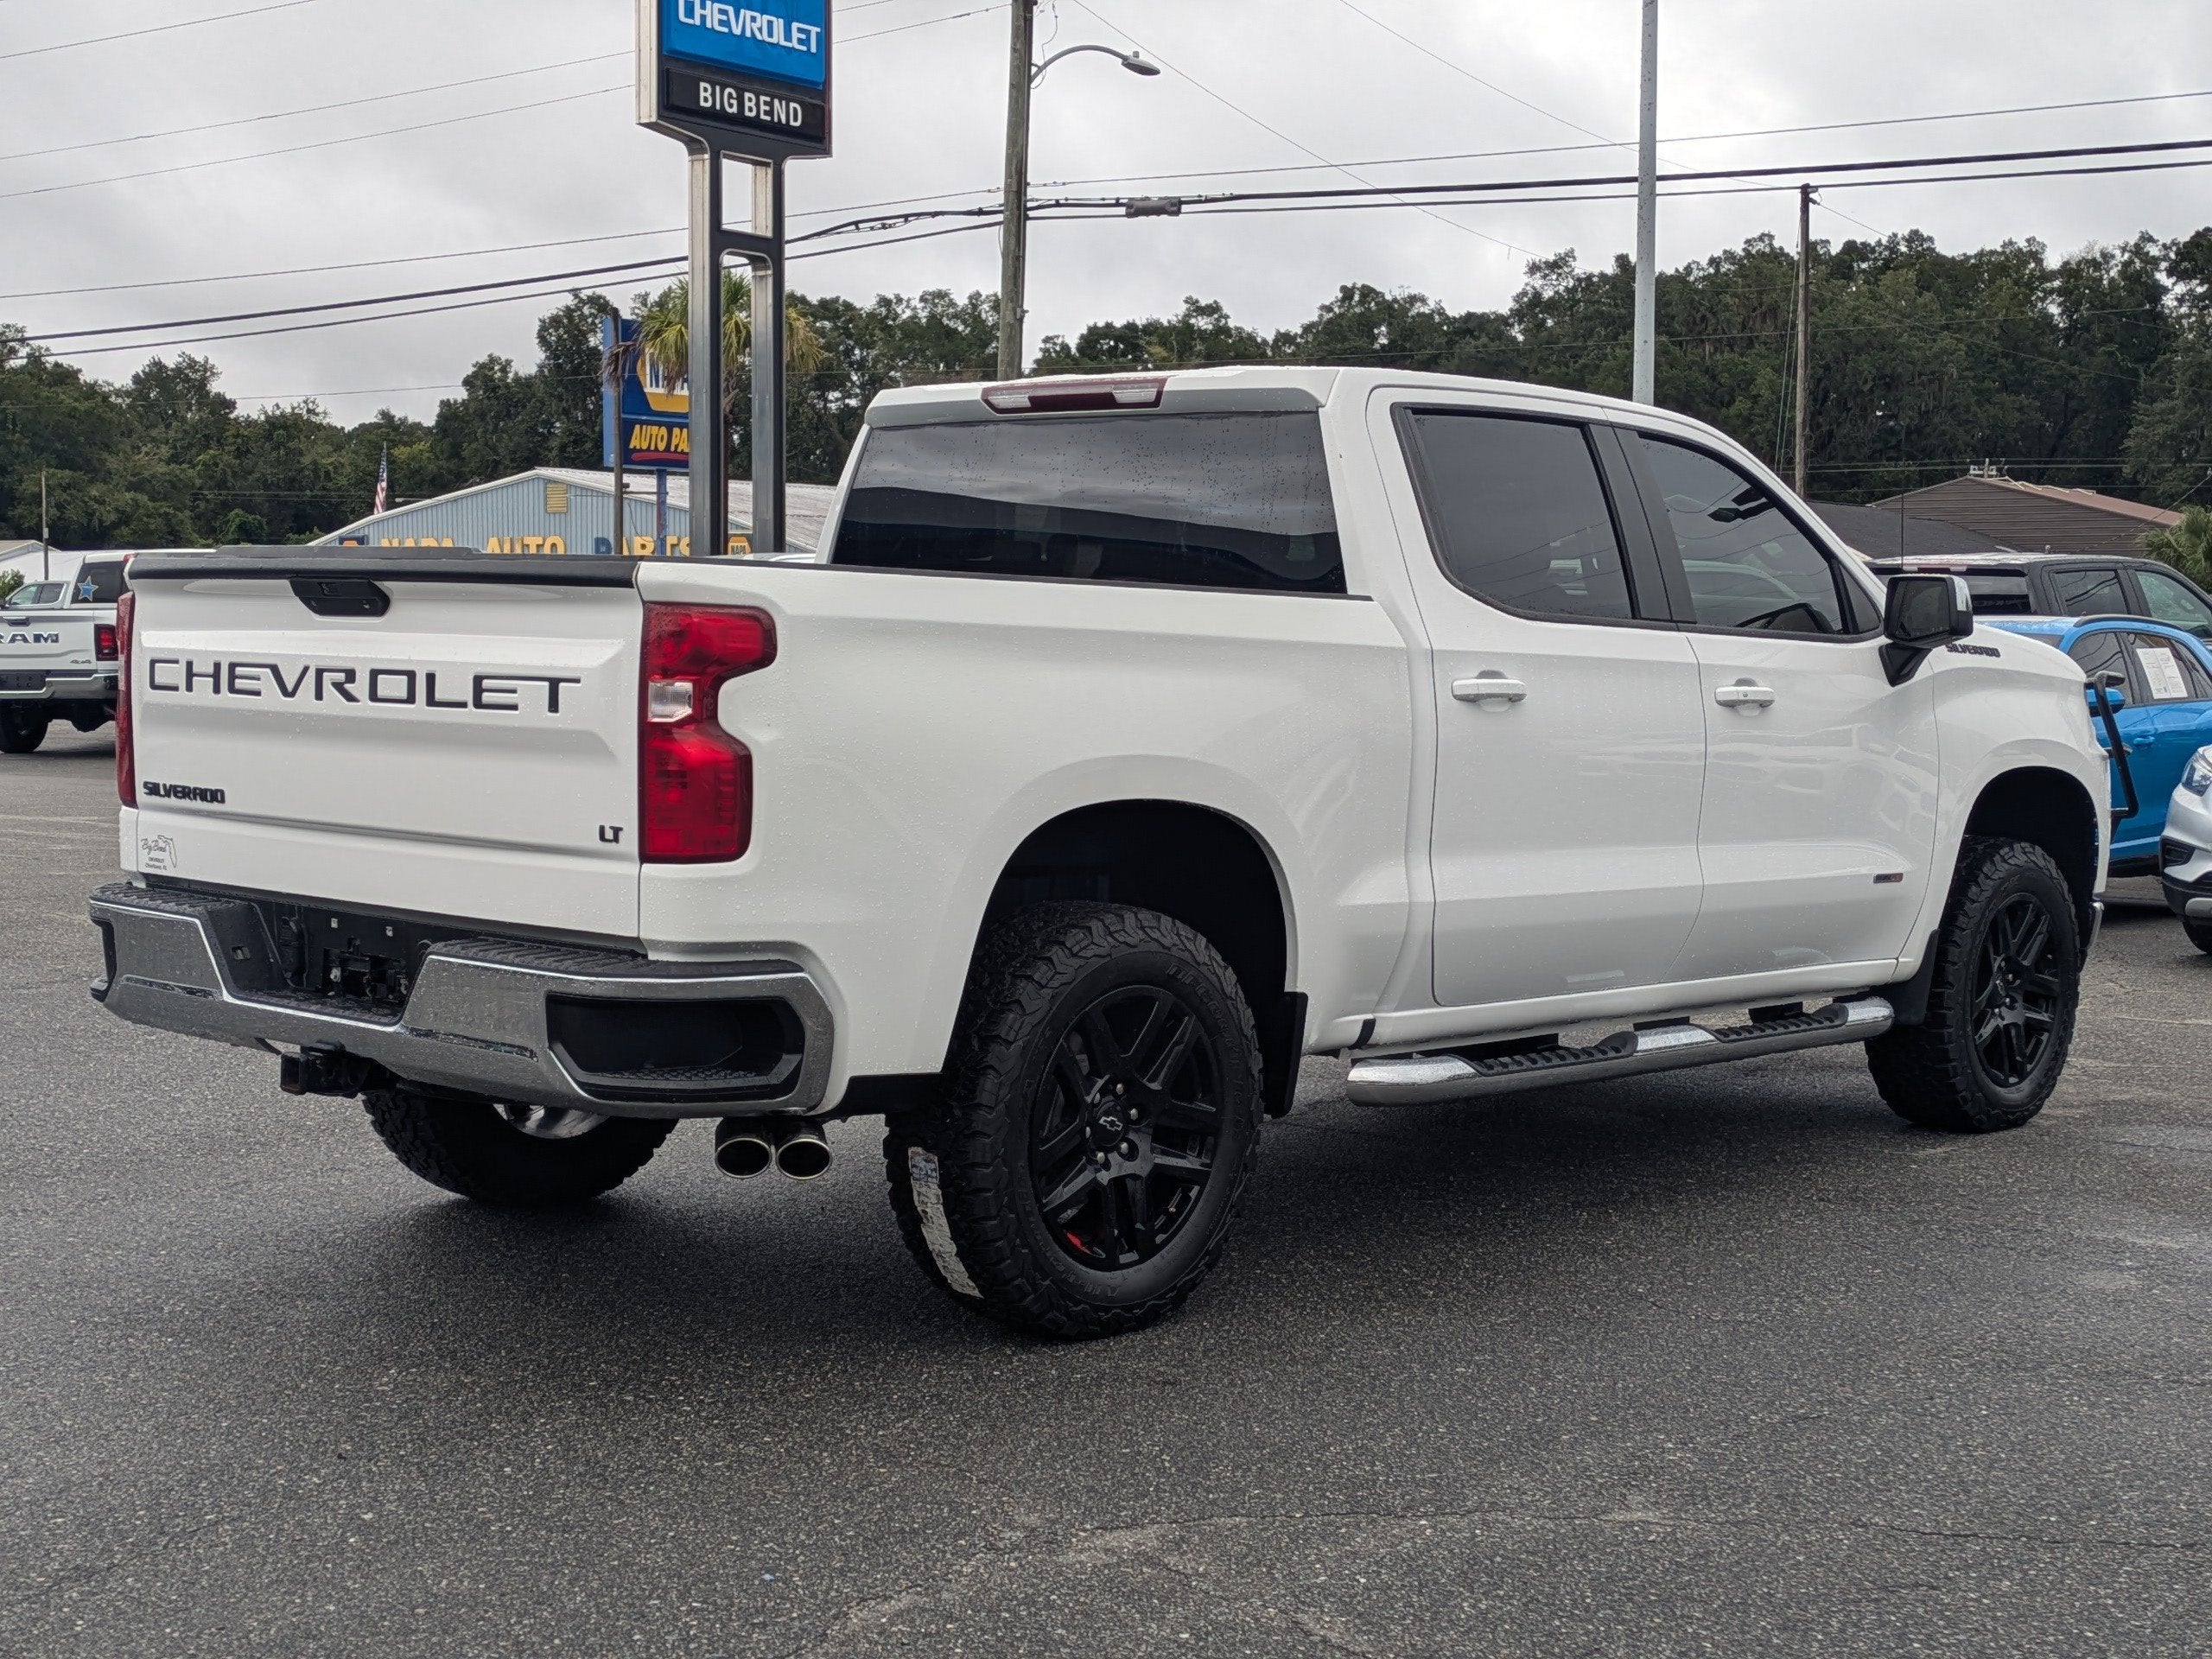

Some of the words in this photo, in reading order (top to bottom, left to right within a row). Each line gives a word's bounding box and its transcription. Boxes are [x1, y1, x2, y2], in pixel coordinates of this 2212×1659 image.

[678, 0, 820, 53] CHEVROLET
[699, 82, 737, 113] BIG
[744, 92, 803, 127] BEND
[629, 424, 667, 451] AUTO
[149, 658, 581, 714] CHEVROLET
[143, 781, 226, 804] SILVERADO
[599, 824, 624, 844] LT
